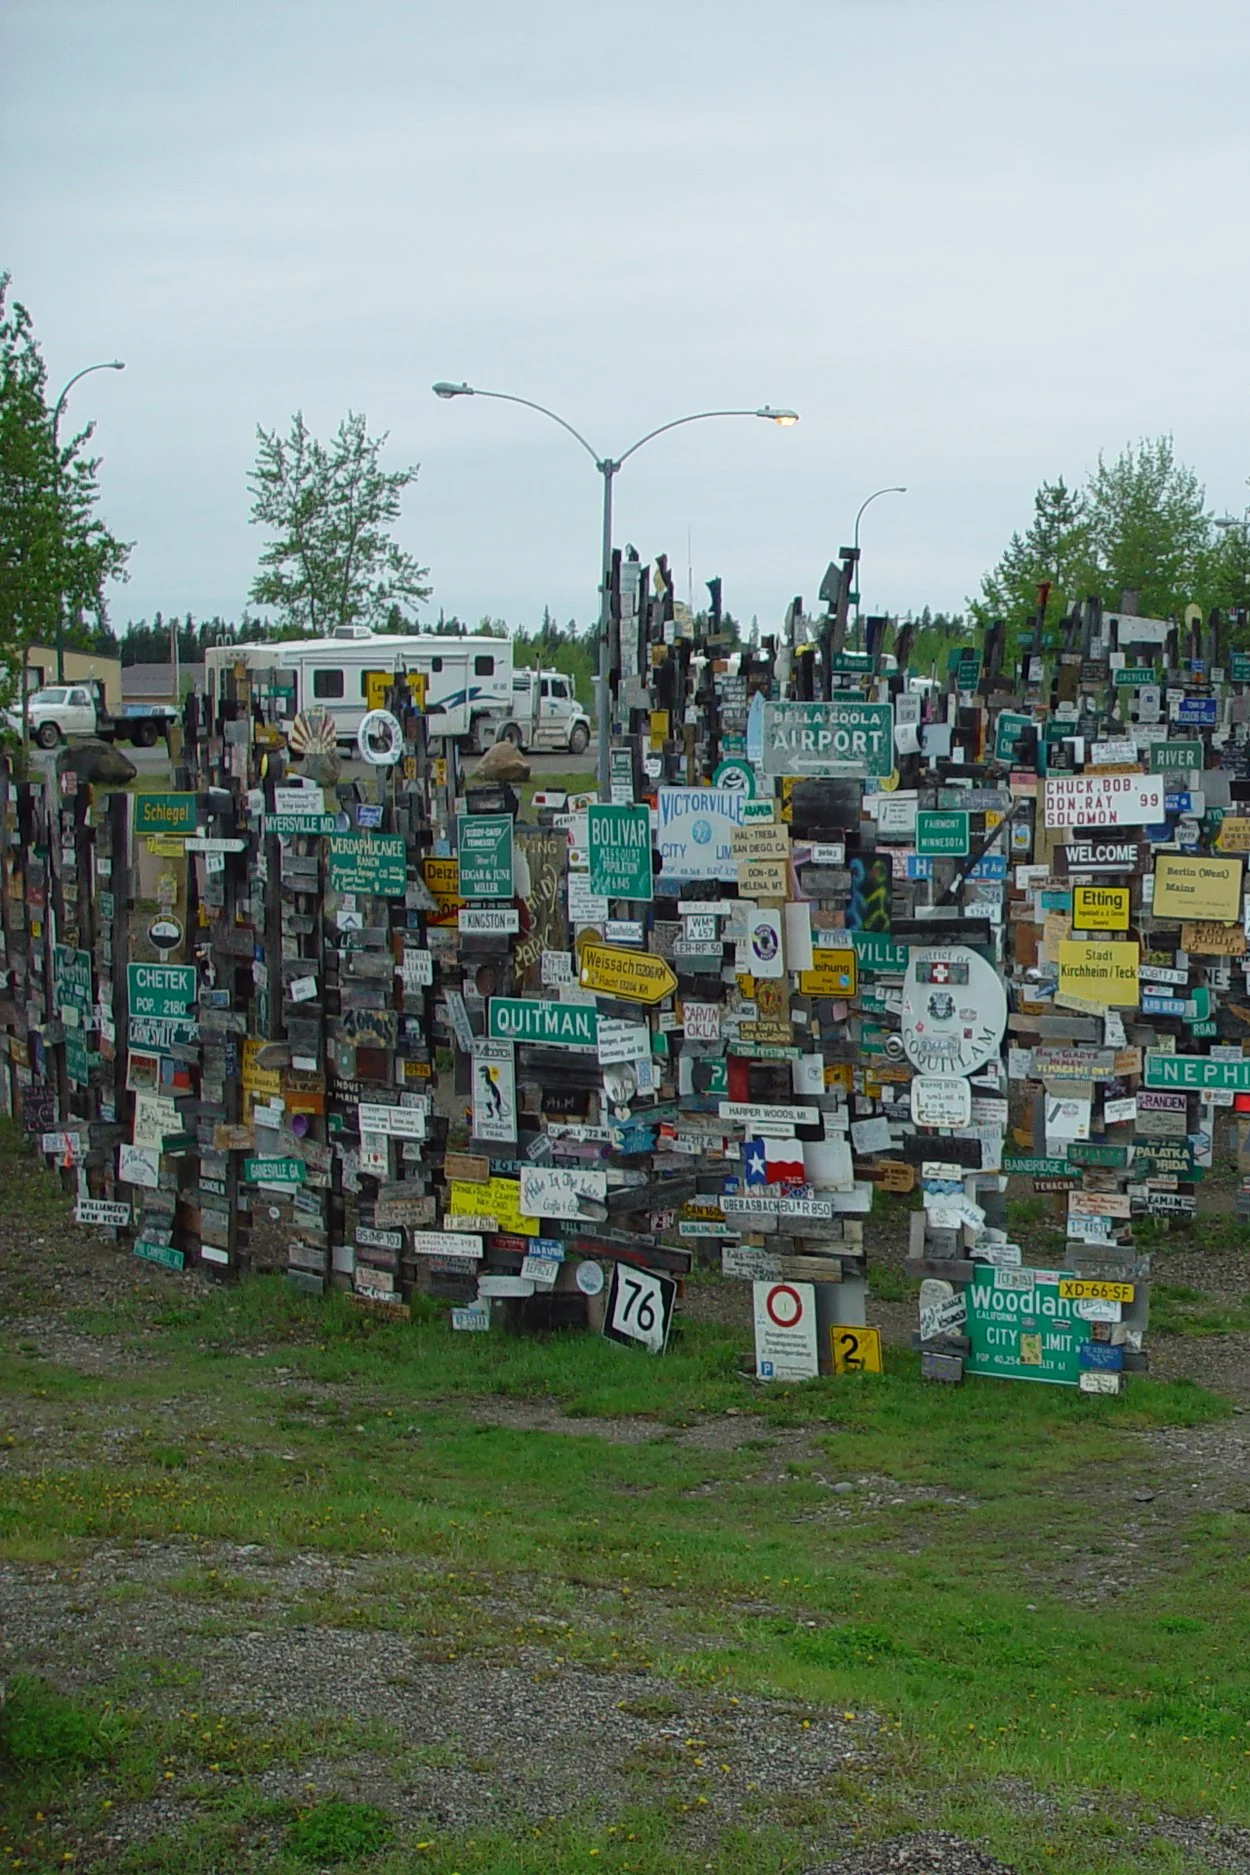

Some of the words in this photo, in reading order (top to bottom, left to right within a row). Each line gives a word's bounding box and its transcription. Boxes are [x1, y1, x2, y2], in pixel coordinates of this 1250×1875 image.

[773, 711, 821, 725] BELLA
[829, 712, 881, 725] COOLA
[772, 729, 884, 753] AIRPORT
[1157, 750, 1195, 765] RIVER
[1139, 794, 1159, 807] 99
[144, 802, 190, 825] Schlegel
[661, 792, 744, 826] VICTORVILLE
[265, 816, 319, 832] MYERSVILLE
[923, 818, 960, 830] FAIRMONT
[1046, 810, 1118, 826] SOLOMON
[592, 817, 647, 848] BOLIVAR
[733, 844, 748, 854] SAN
[920, 836, 965, 848] MINNESOTA
[661, 842, 687, 859] CITY
[1065, 845, 1139, 862] WELCOME
[462, 869, 486, 880] EDGAR
[474, 882, 500, 894] MILLER
[1082, 890, 1122, 909] Etting
[467, 913, 507, 930] KINGSTON
[697, 928, 714, 938] 457
[709, 943, 722, 954] 50
[1085, 949, 1113, 961] Stadt
[586, 951, 637, 975] Weissach
[136, 968, 188, 990] CHETEK
[1061, 964, 1107, 978] Kirchheim
[1113, 967, 1136, 979] Teck
[136, 999, 156, 1014] POP.
[163, 999, 187, 1015] 2180
[684, 1006, 720, 1023] CARVIN
[497, 1007, 593, 1040] QUITMAN,
[687, 1023, 720, 1039] OKLA
[903, 1026, 997, 1073] COQUITLAM
[1163, 1062, 1250, 1085] NEPHI
[729, 1106, 761, 1118] HARPER
[763, 1107, 796, 1120] WOODS,
[1136, 1145, 1191, 1160] PALATKA
[1005, 1158, 1056, 1172] BAINBRIDGE
[79, 1200, 130, 1214] WILLIAMSON
[722, 1197, 782, 1214] OBERASBACH
[811, 1202, 830, 1216] 850
[79, 1211, 98, 1222] NEW
[99, 1212, 126, 1224] YORK
[1064, 1282, 1131, 1301] XD-66-SF
[623, 1277, 655, 1332] 76
[976, 1311, 1017, 1323] CALIFORNIA
[985, 1328, 1019, 1347] CITY
[1041, 1333, 1073, 1352] LIMIT
[840, 1333, 861, 1364] 2
[763, 1363, 772, 1374] P
